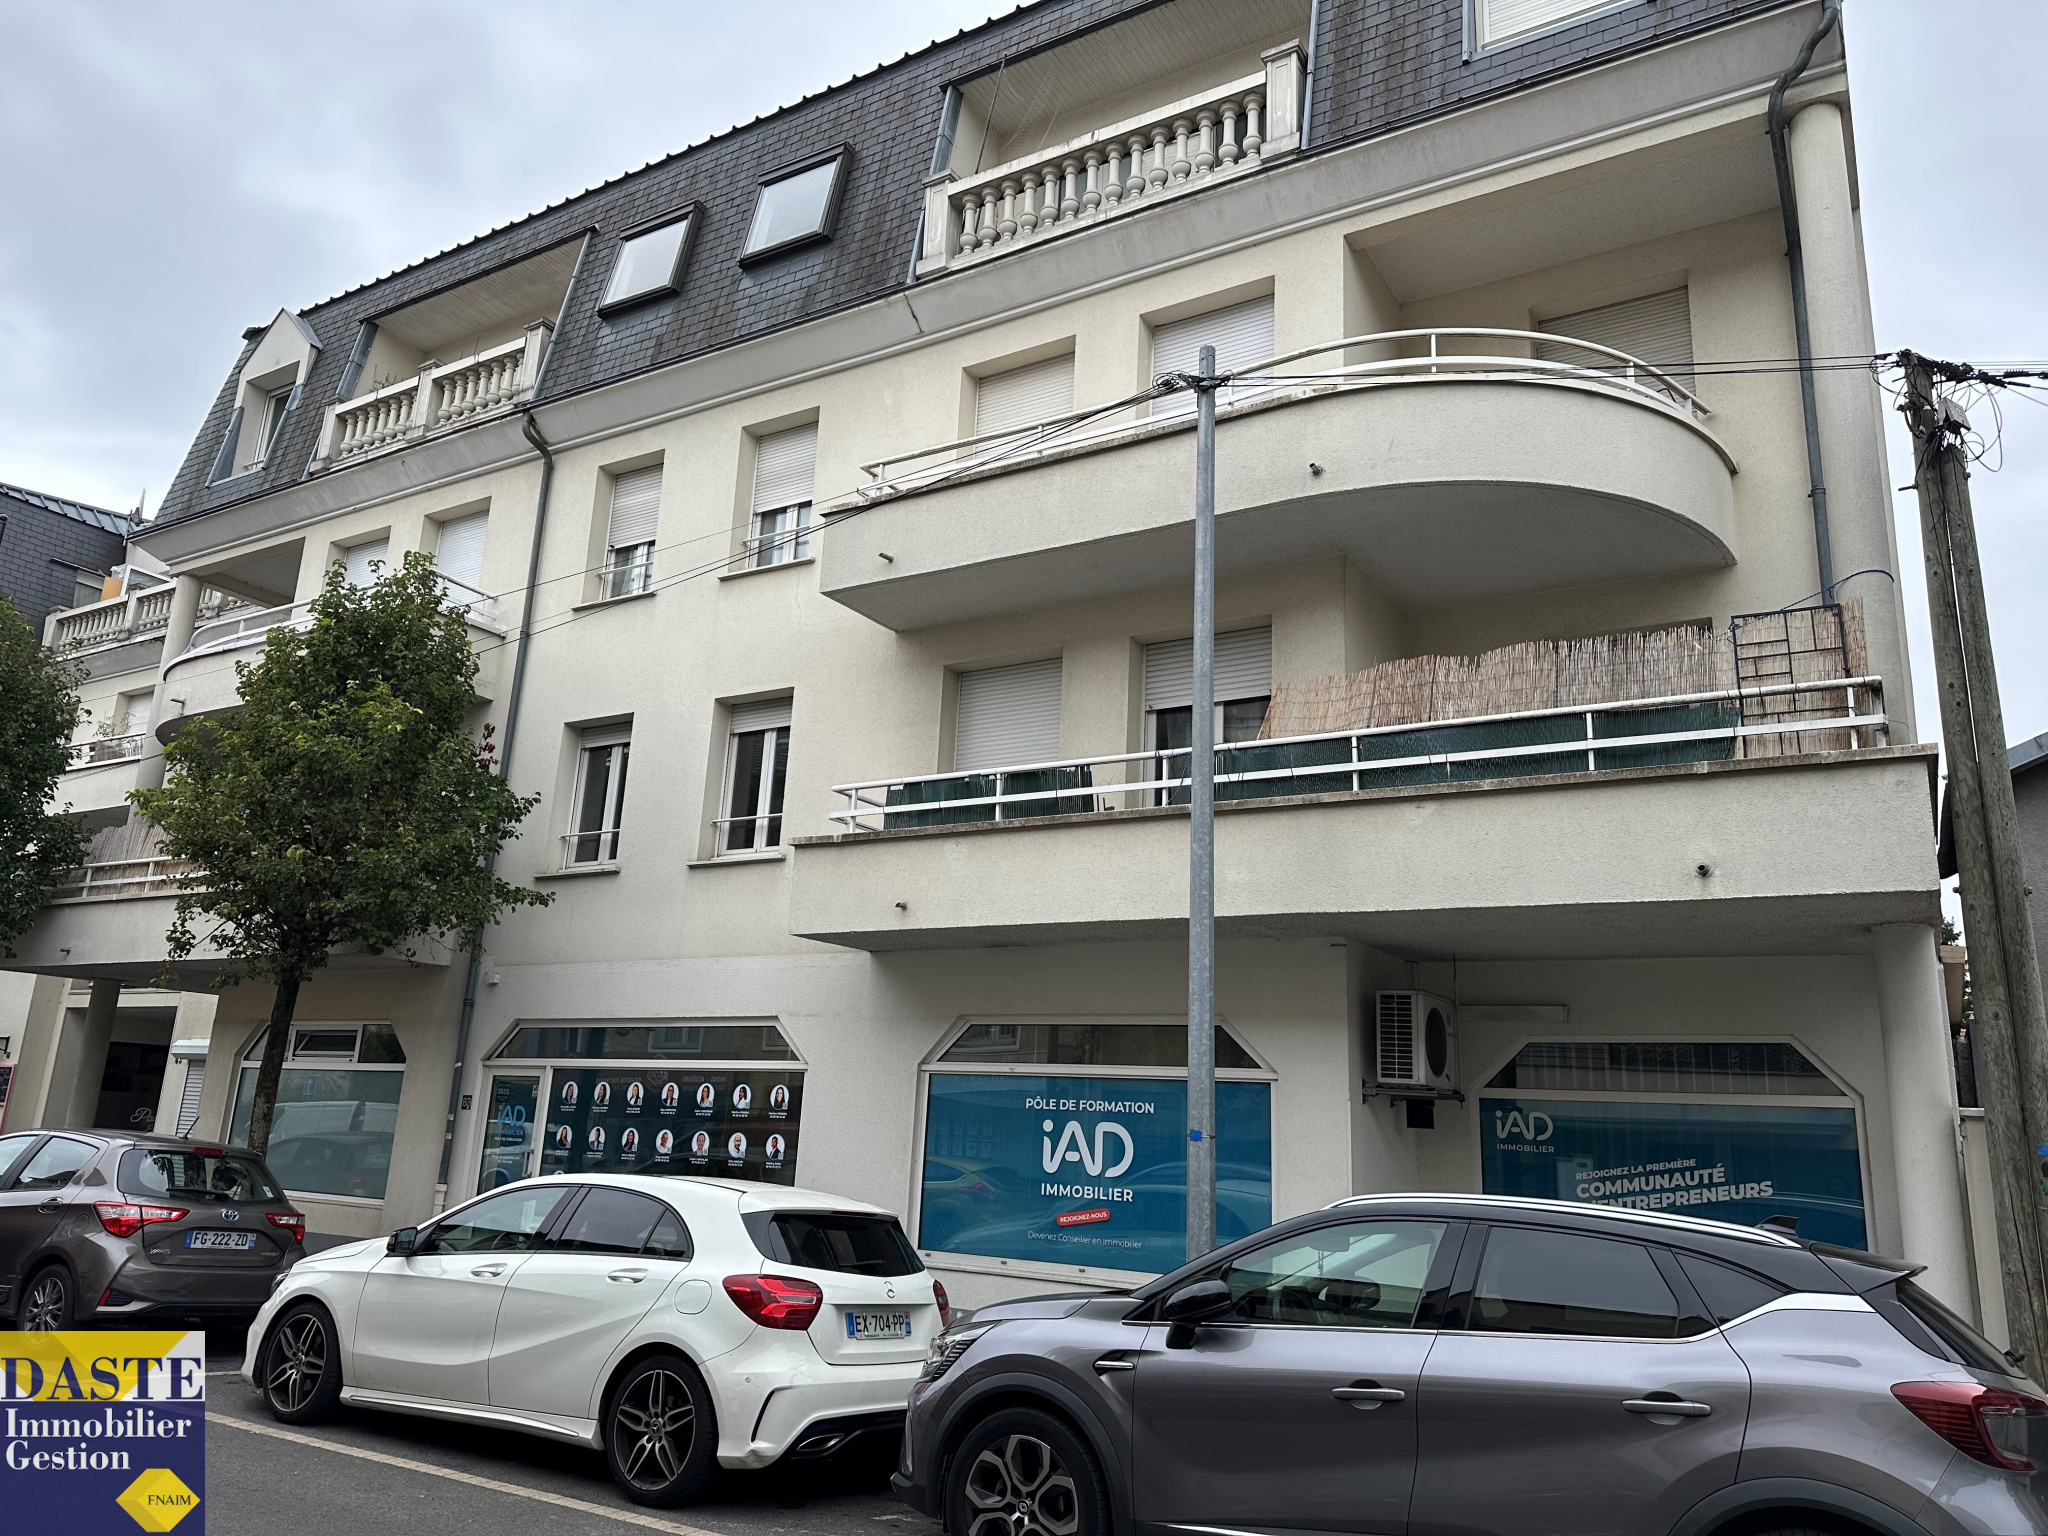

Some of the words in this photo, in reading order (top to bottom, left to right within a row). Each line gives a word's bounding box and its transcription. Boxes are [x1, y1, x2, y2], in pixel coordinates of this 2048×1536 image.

[1026, 1095, 1057, 1110] PÔLE
[1060, 1099, 1077, 1111] DE
[1079, 1100, 1155, 1114] FORMATION
[1497, 1143, 1554, 1153] IMMOBILIER
[1576, 1167, 1629, 1180] REJOIGNEZ
[1631, 1166, 1645, 1174] LA
[1646, 1158, 1696, 1172] PREMIÈRE
[1576, 1163, 1725, 1198] COMMUNAUTÉ
[1041, 1182, 1134, 1202] IMMOBILIER
[1591, 1181, 1774, 1209] 'NTREPRENEURS
[1060, 1211, 1107, 1222] REJOIGNEZ-NOUS
[193, 1232, 249, 1246] FG-222-ZD
[1028, 1231, 1057, 1240] Devenez
[1058, 1234, 1091, 1243] Conseiller
[855, 1315, 904, 1332] EX-704-PP
